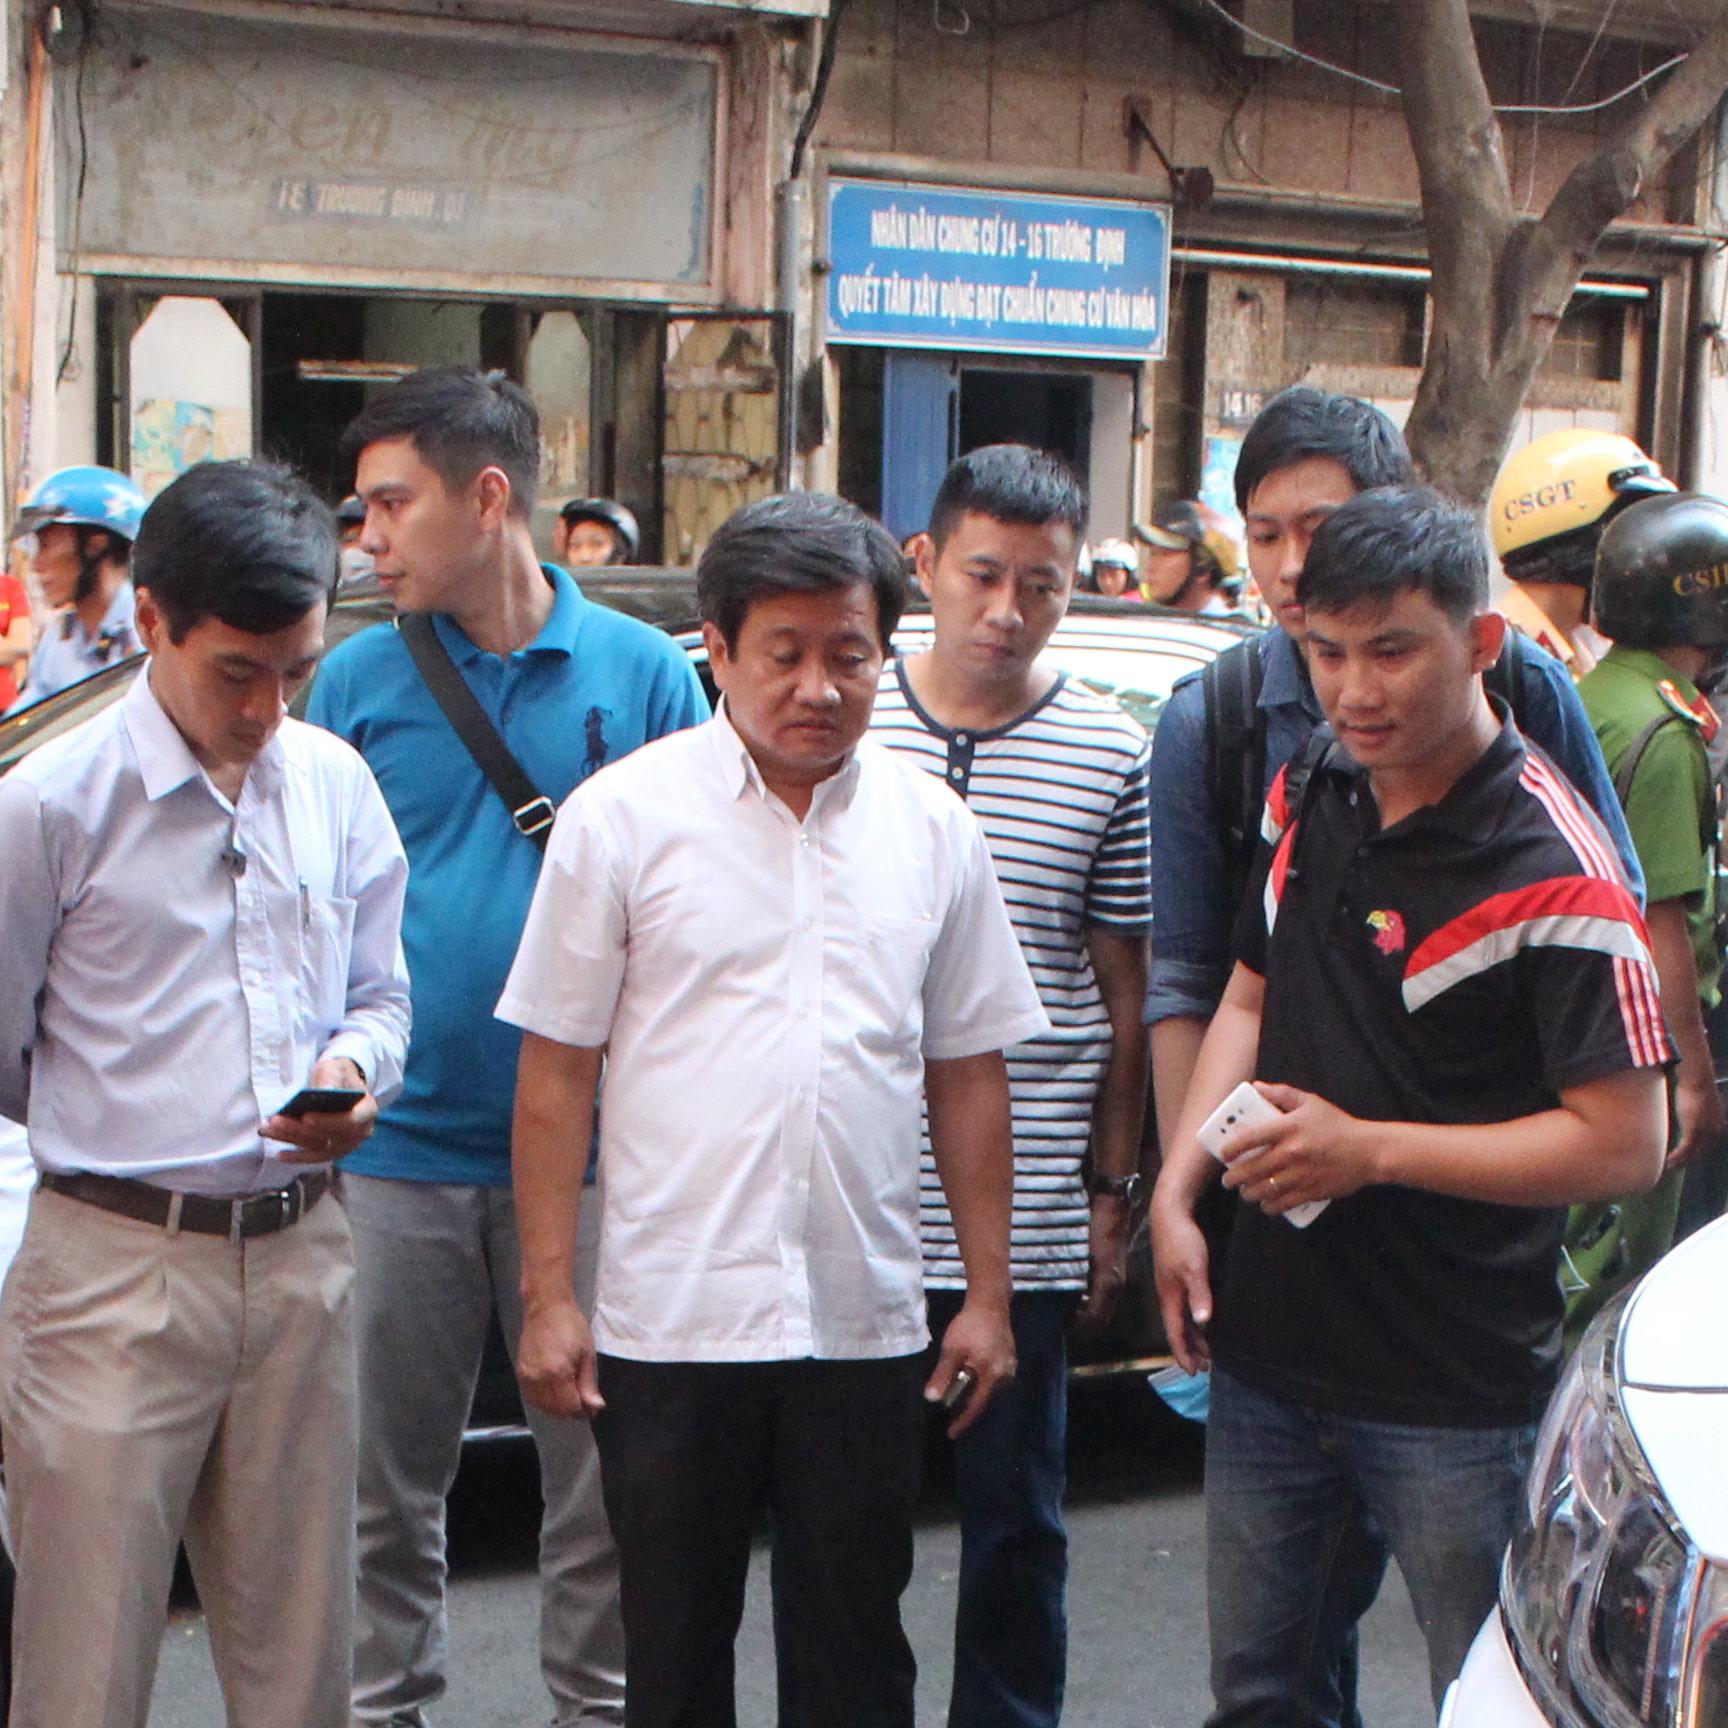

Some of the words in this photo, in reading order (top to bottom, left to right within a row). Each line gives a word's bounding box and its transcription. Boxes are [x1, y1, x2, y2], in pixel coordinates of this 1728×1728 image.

[938, 213, 979, 255] CHUNG
[1000, 220, 1017, 259] 14
[1027, 222, 1044, 260] 16
[1046, 287, 1086, 328] CHUNG
[1503, 478, 1576, 521] CSGT
